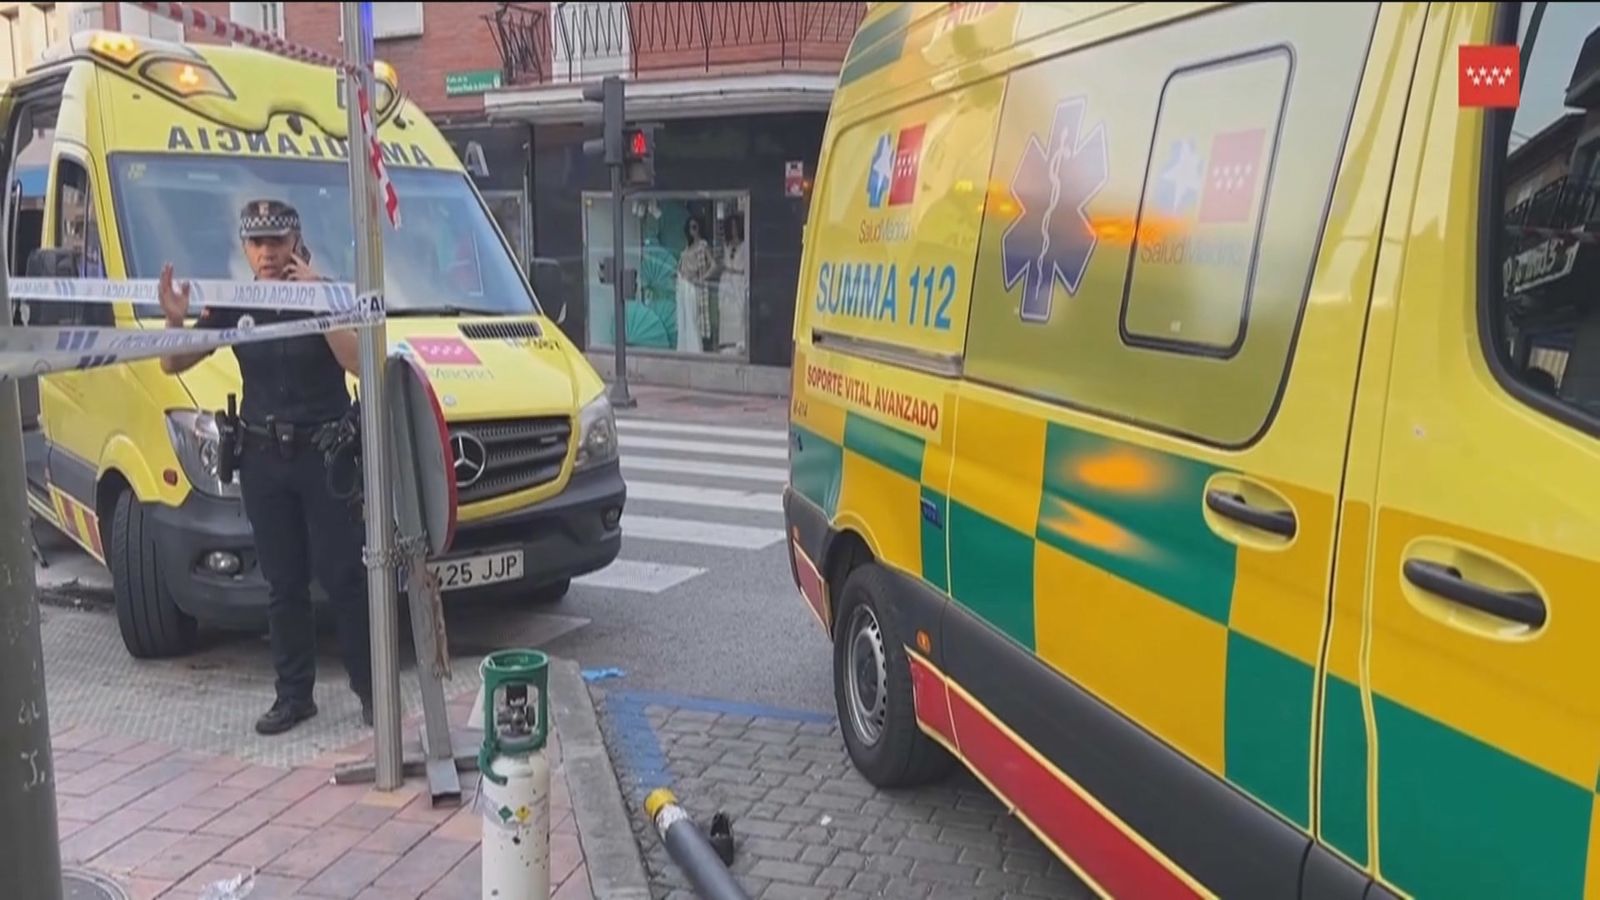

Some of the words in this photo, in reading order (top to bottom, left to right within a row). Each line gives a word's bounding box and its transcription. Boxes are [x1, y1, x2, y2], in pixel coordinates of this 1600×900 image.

[816, 262, 897, 323] SUMMA
[909, 264, 956, 330] 112
[807, 365, 843, 397] SOPORTE
[844, 376, 871, 408] VITAL
[873, 386, 939, 431] AVANZADO
[481, 554, 517, 581] JJP
